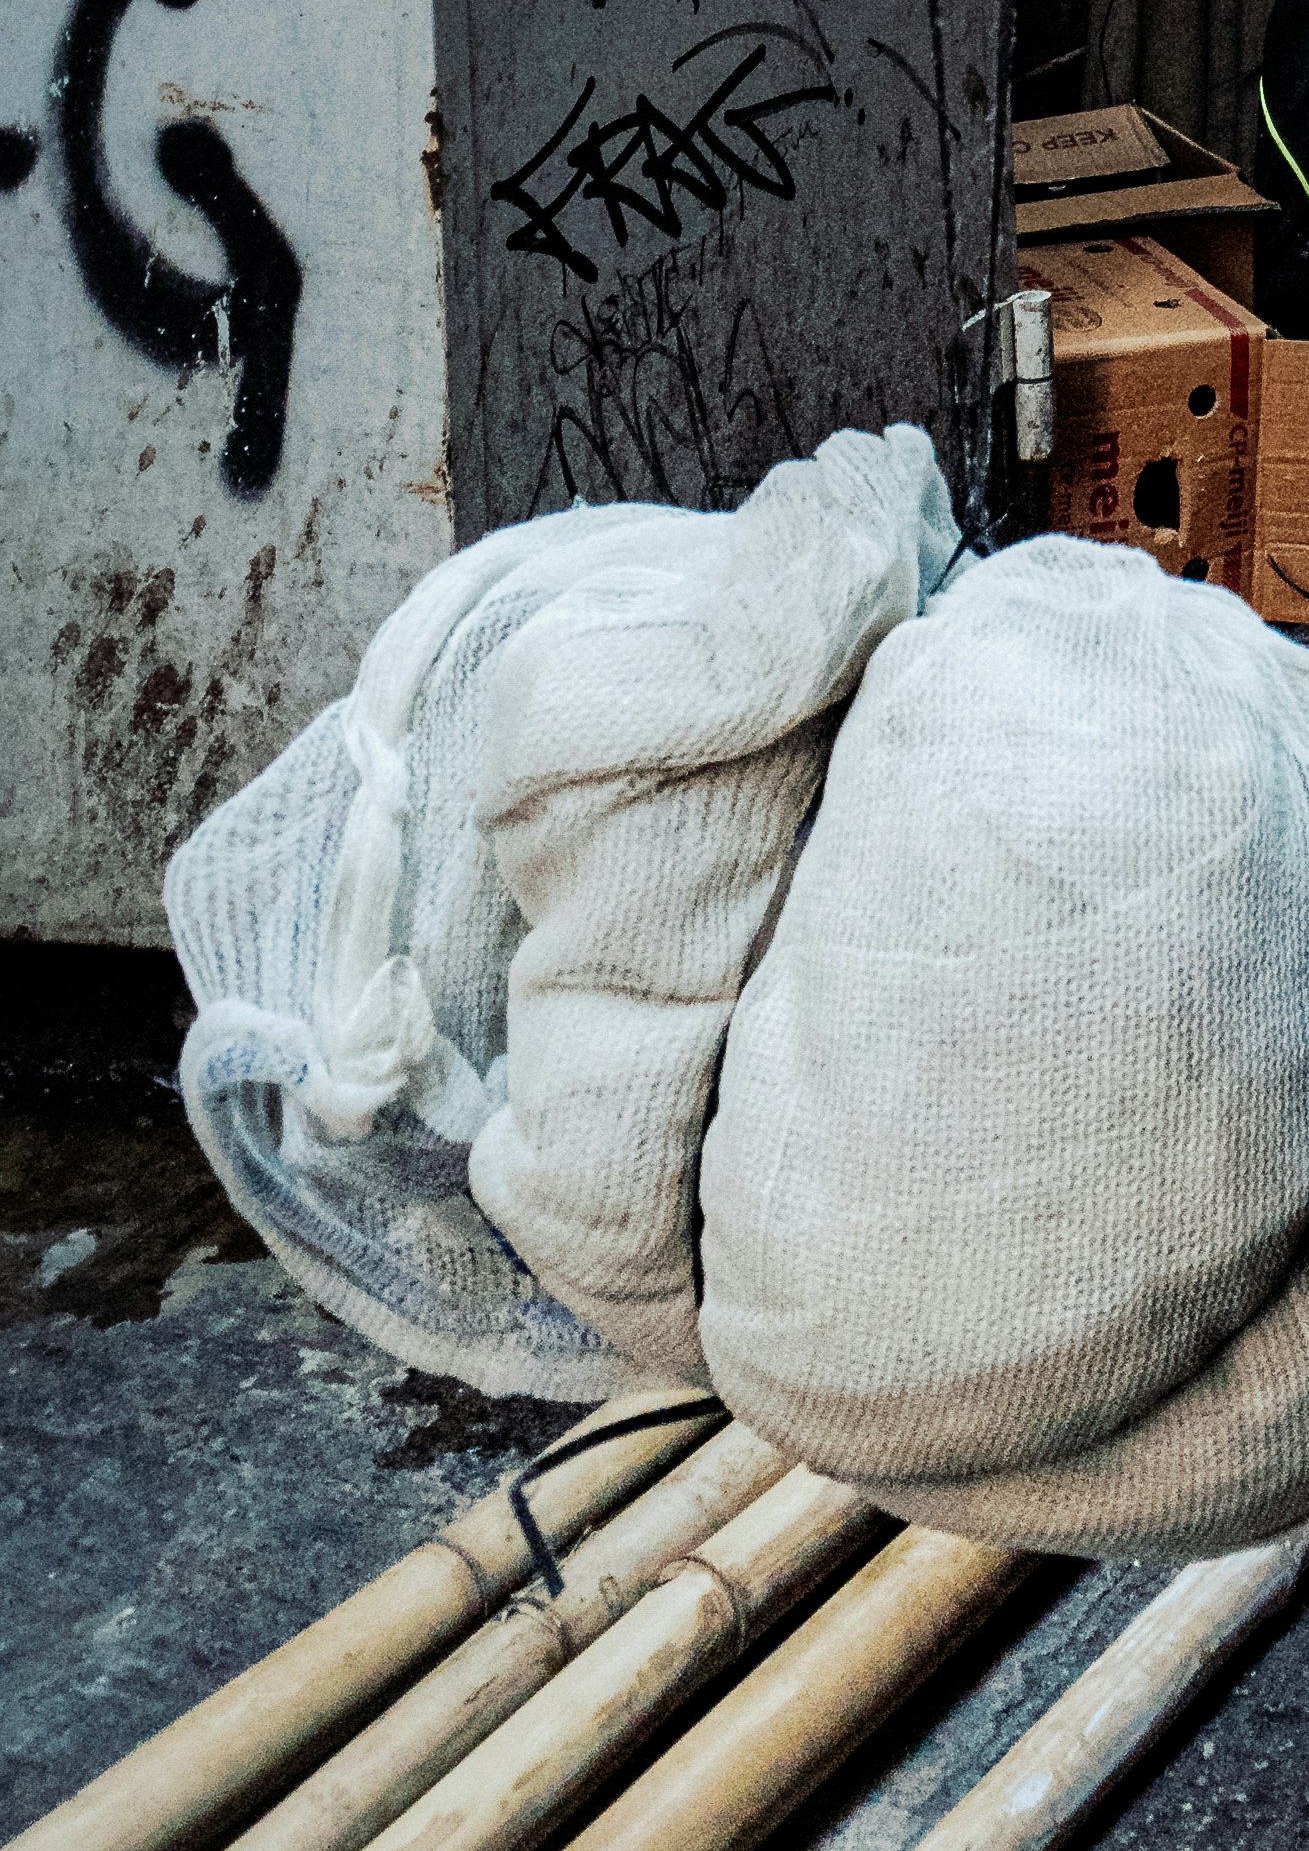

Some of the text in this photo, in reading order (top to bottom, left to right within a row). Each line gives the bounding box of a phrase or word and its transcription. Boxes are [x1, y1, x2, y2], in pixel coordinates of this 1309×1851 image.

[1041, 127, 1121, 151] KEEP
[1089, 430, 1130, 544] mei
[1219, 424, 1249, 539] CP-meiji
